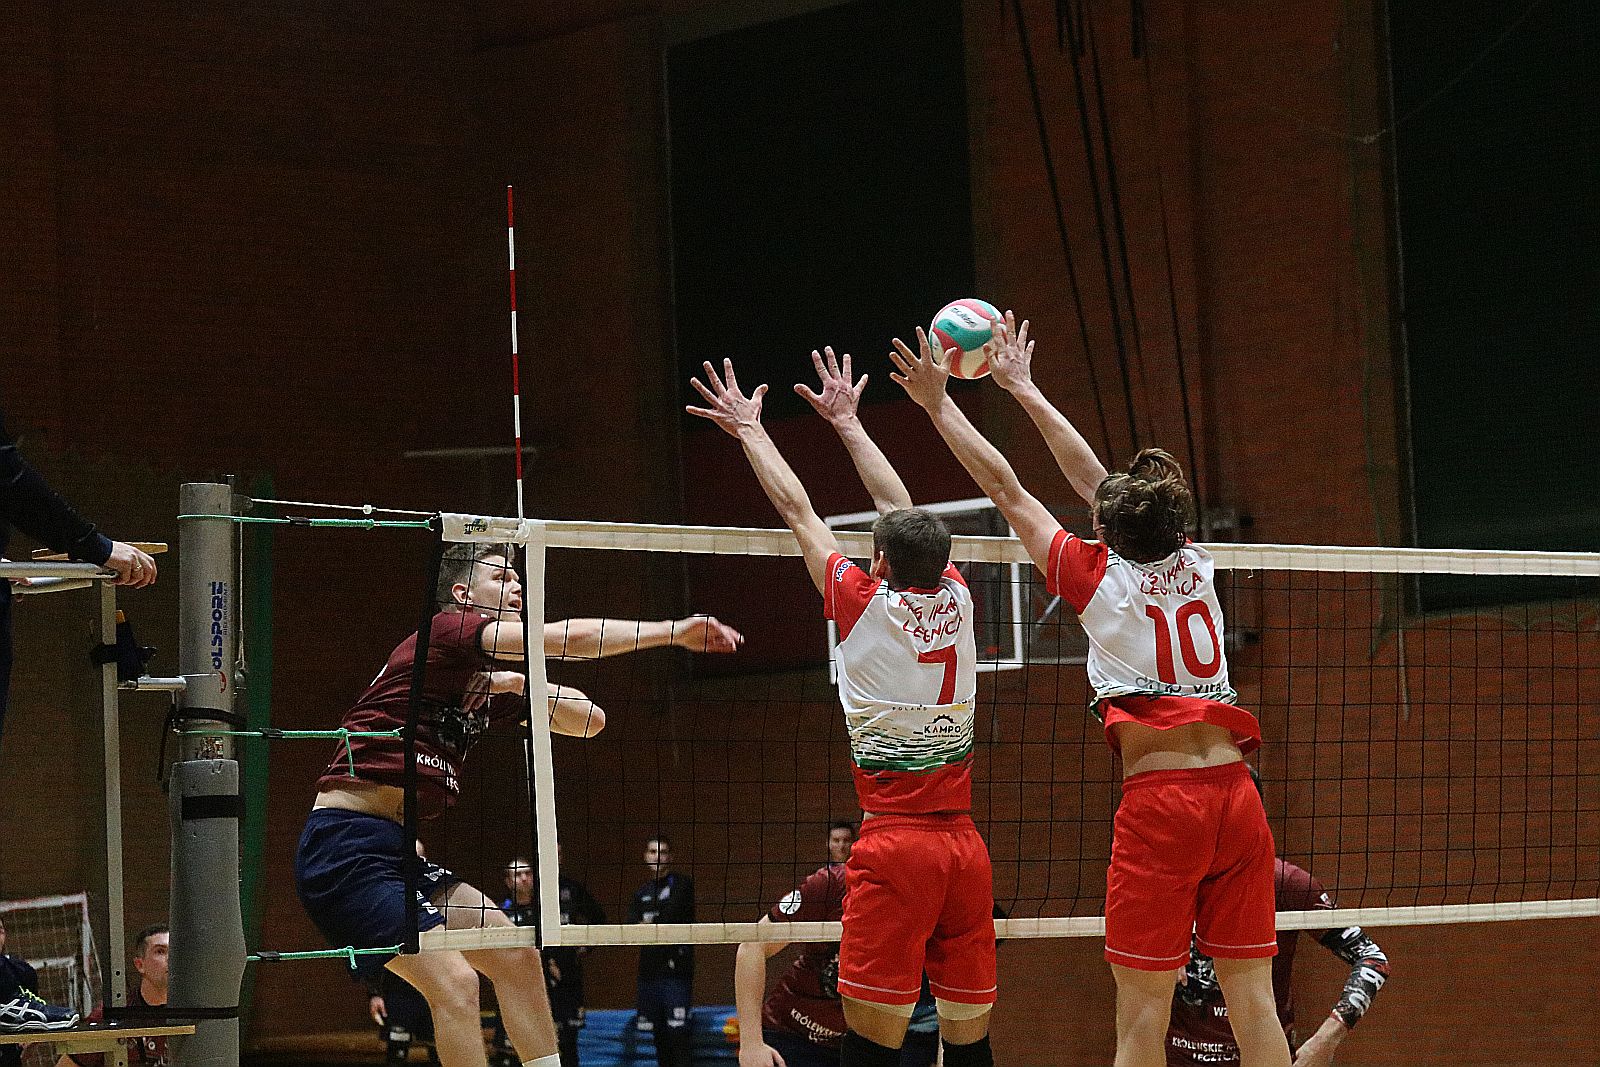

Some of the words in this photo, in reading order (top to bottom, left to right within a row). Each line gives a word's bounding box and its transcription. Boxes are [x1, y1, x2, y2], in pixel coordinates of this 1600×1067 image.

[1140, 572, 1203, 596] LEGICA
[1145, 599, 1221, 685] 10
[917, 644, 958, 706] 7
[924, 725, 961, 734] KAMPO
